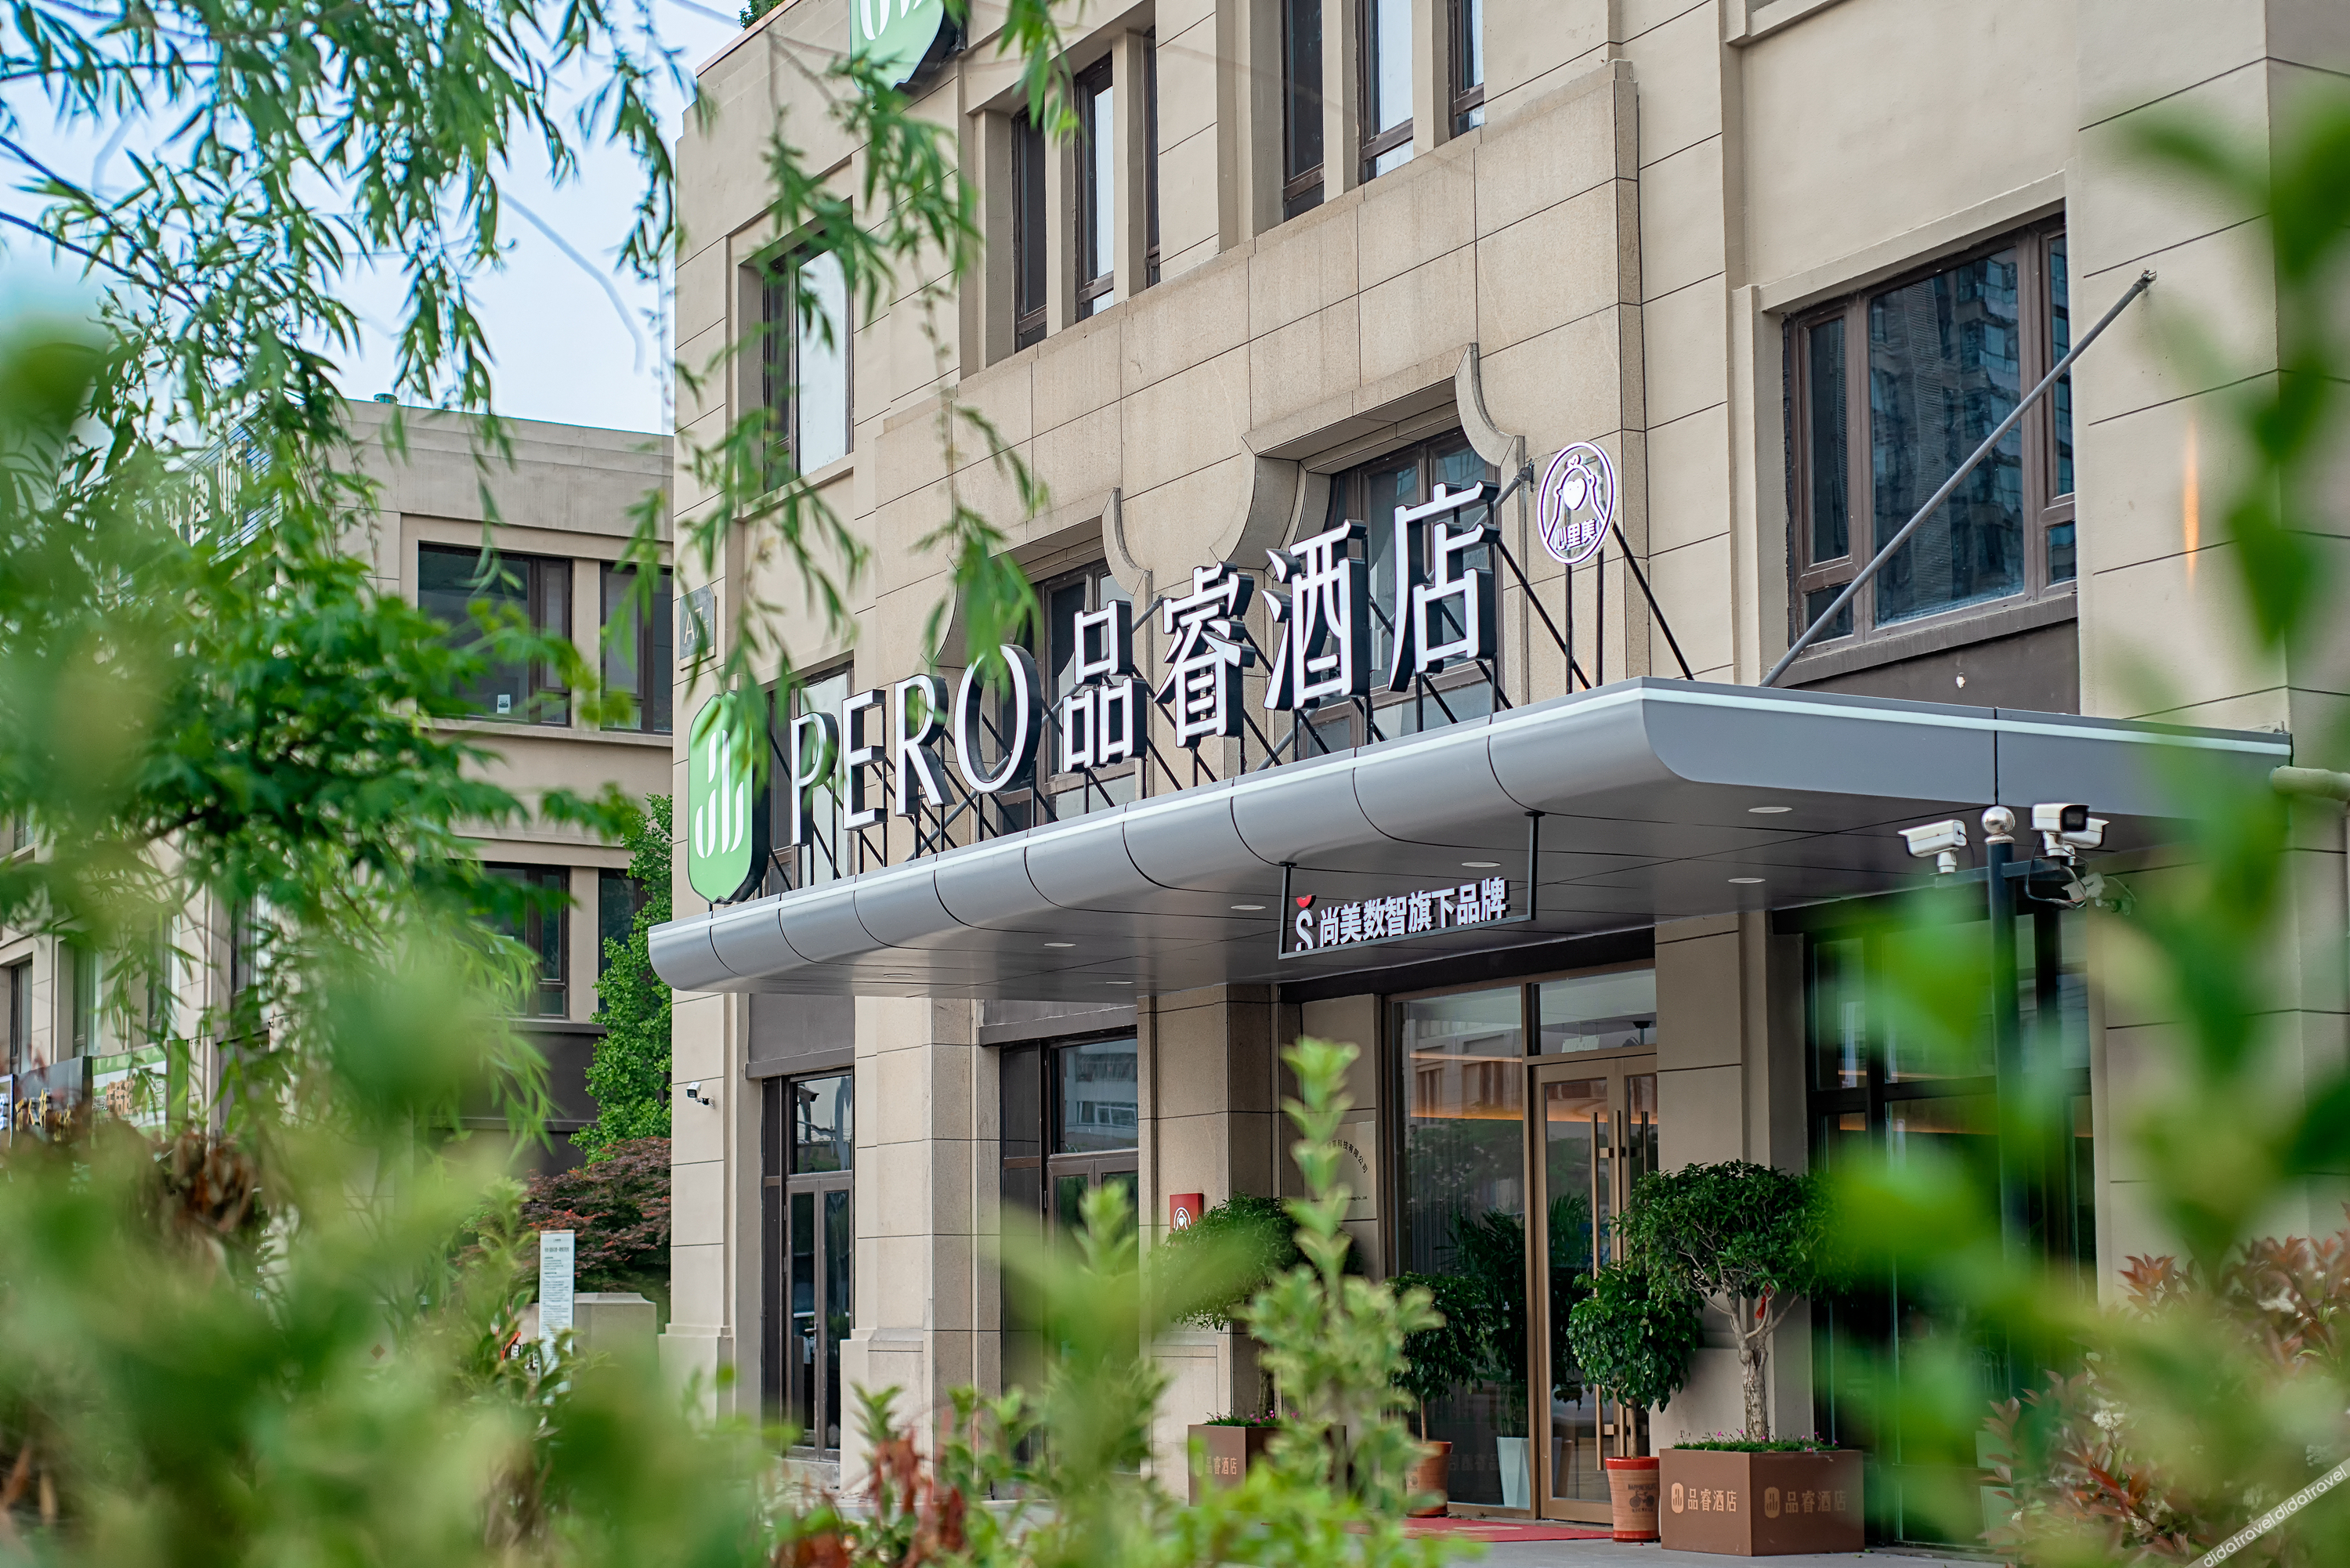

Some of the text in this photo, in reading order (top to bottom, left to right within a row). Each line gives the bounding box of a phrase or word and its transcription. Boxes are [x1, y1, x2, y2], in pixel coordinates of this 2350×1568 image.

[1554, 518, 1596, 550] 心里美
[790, 480, 1492, 847] PERO 品睿酒店
[1319, 876, 1506, 948] 尚美数智旗下品牌
[1206, 1456, 1237, 1475] 品睿酒店
[1687, 1487, 1737, 1512] 品睿酒店
[1785, 1490, 1847, 1514] 品睿酒店
